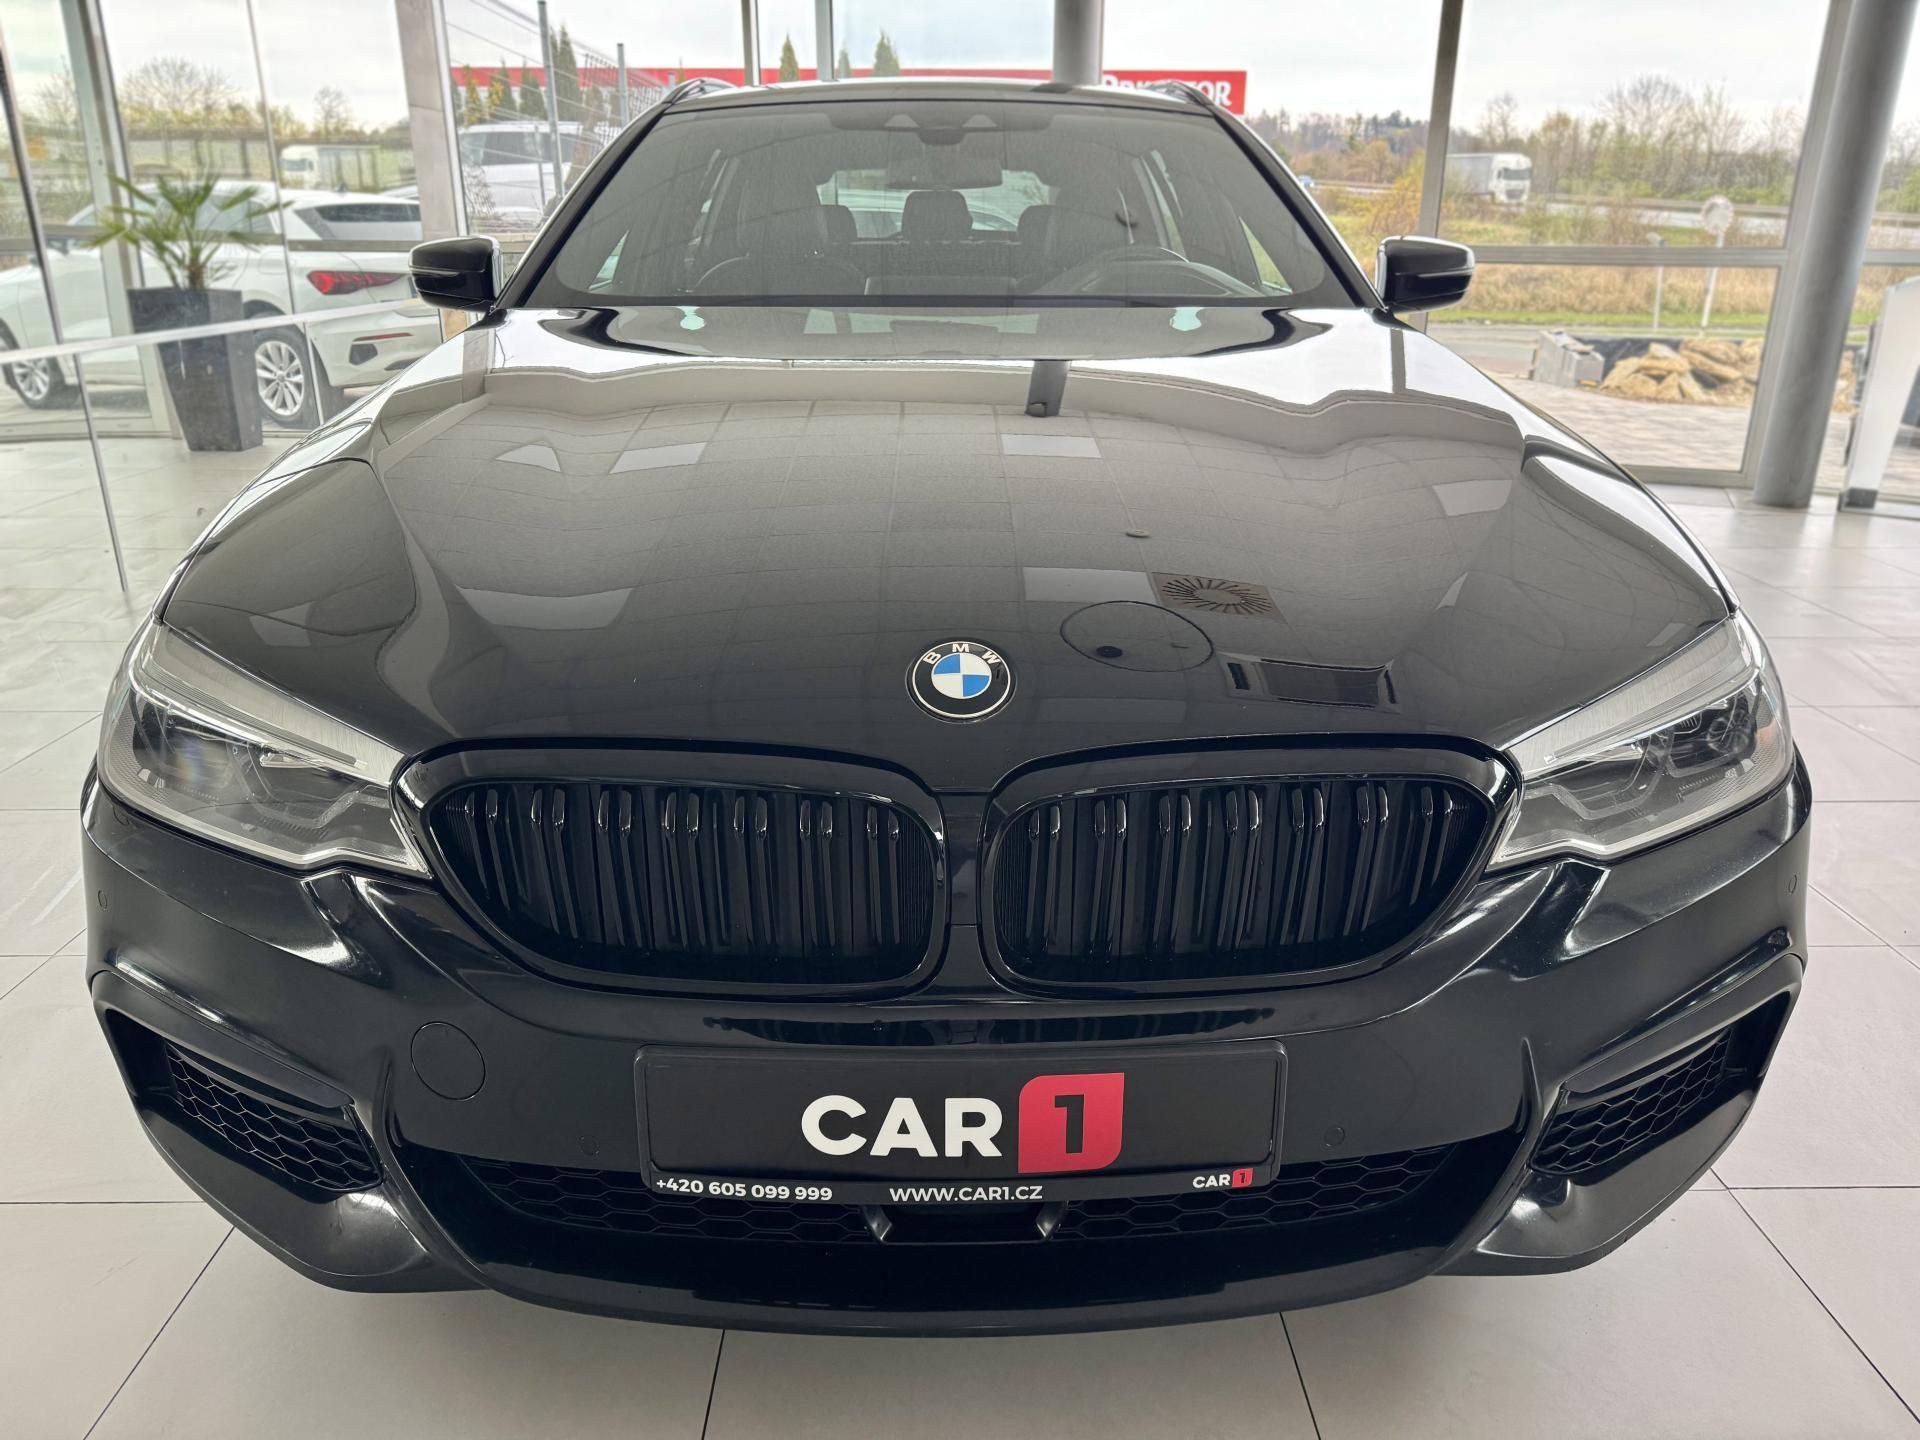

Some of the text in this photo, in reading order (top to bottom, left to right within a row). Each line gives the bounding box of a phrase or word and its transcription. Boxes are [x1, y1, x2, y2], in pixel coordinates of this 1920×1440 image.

[923, 643, 1001, 665] BMW
[801, 1094, 1085, 1158] CAR 1
[656, 1177, 833, 1201] +420 605 099 999
[1192, 1174, 1231, 1189] CAR
[889, 1185, 1043, 1202] WWW.CAR1.CZ
